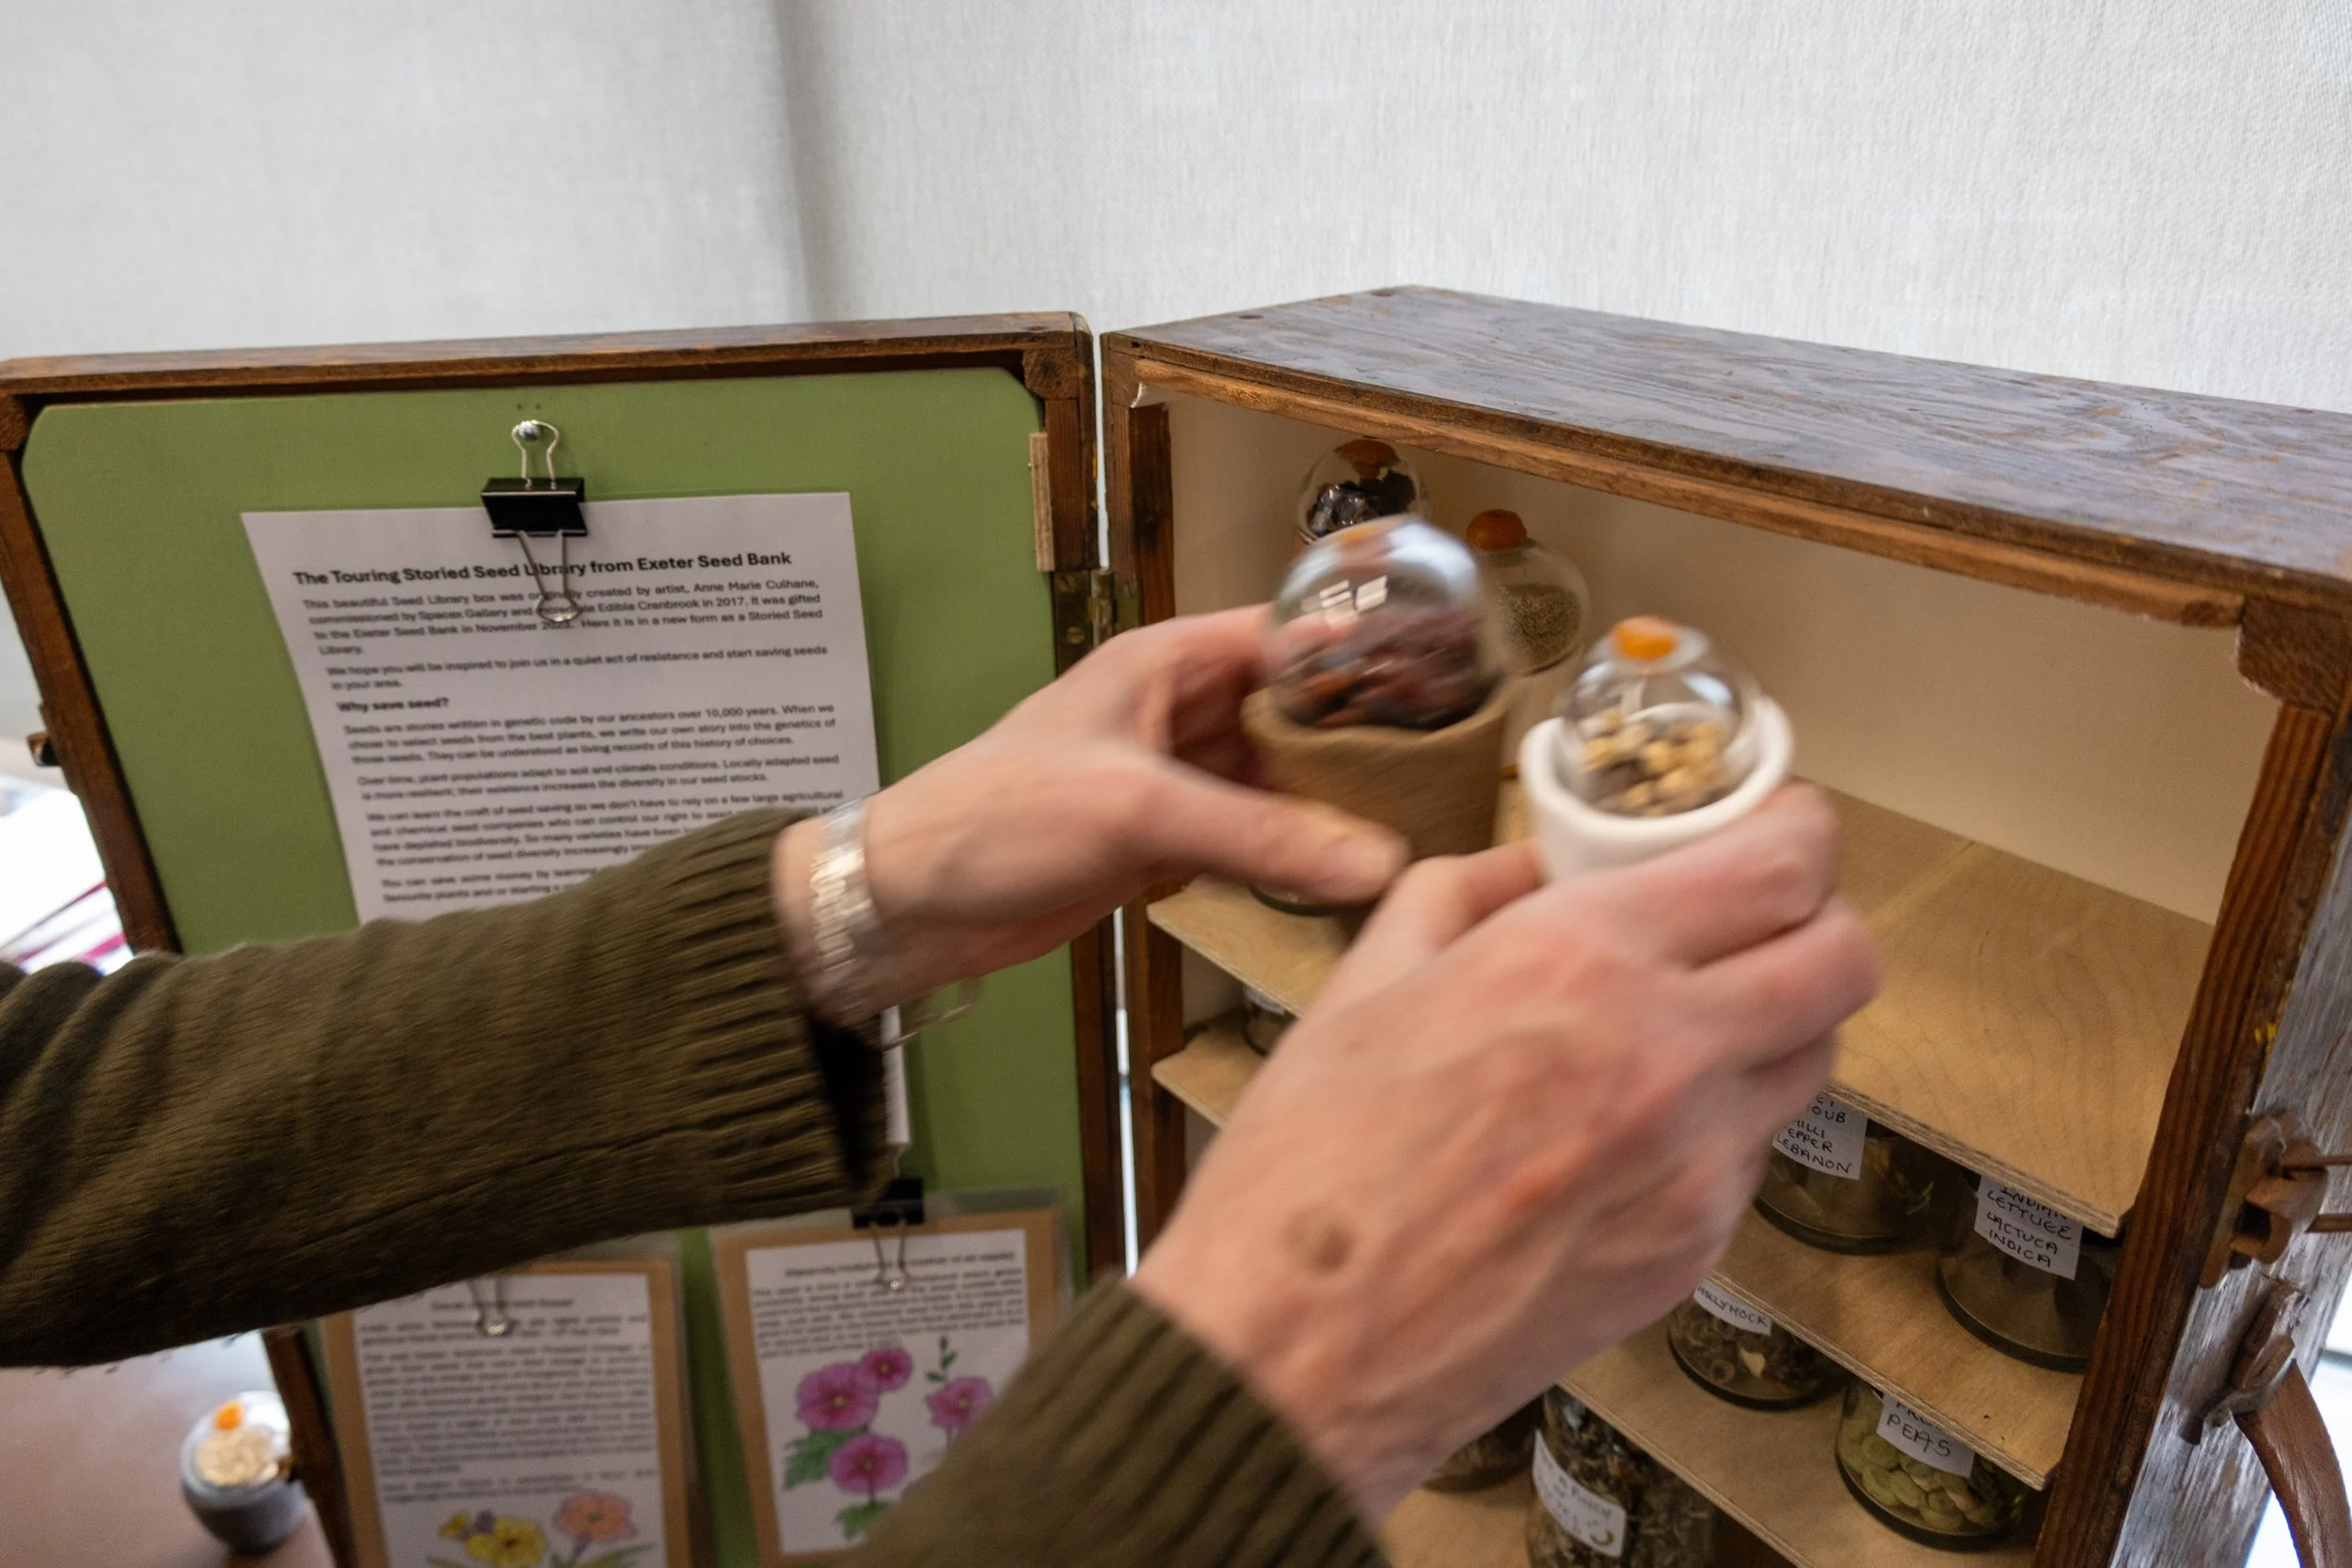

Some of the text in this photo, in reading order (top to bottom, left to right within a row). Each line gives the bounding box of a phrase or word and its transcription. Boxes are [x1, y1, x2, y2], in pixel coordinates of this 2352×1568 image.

[293, 570, 327, 585] The
[330, 567, 401, 587] Touring
[403, 565, 469, 581] Storied
[474, 563, 518, 578] Seed
[590, 559, 632, 573] from
[638, 555, 693, 571] Exeter
[698, 553, 742, 568] Seed
[747, 550, 792, 565] Bank
[586, 587, 631, 598] created
[636, 585, 649, 596] by
[693, 581, 723, 593] Anne
[728, 580, 760, 591] Marie
[597, 601, 634, 612] Edible
[638, 598, 698, 610] Cranbrook
[702, 598, 713, 608] in
[751, 595, 759, 606] It
[761, 596, 785, 605] was
[788, 594, 820, 606] gifted
[581, 617, 609, 628] Here
[612, 617, 619, 626] it
[624, 617, 633, 626] is
[637, 616, 648, 626] in
[652, 617, 659, 626] a
[662, 616, 686, 625] new
[690, 612, 717, 624] form
[721, 613, 734, 622] as
[738, 613, 745, 622] a
[748, 610, 788, 621] Storied
[792, 608, 822, 619] Seed
[563, 657, 570, 666] a
[572, 655, 601, 666] quiet
[604, 654, 623, 664] act
[626, 653, 636, 663] of
[640, 651, 699, 662] resistance
[702, 650, 723, 659] and
[726, 648, 752, 658] start
[755, 647, 790, 658] saving
[793, 645, 827, 656] seeds
[580, 714, 593, 725] by
[596, 714, 614, 723] our
[619, 711, 674, 722] ancestors
[677, 710, 700, 720] over
[706, 706, 742, 719] 10,000
[782, 704, 815, 715] When
[818, 705, 834, 713] we
[599, 729, 615, 737] we
[618, 727, 646, 736] write
[649, 726, 667, 736] our
[671, 725, 694, 735] own
[698, 723, 724, 735] story
[728, 722, 751, 732] into
[754, 721, 771, 731] the
[775, 720, 820, 732] genetics
[824, 718, 835, 728] of
[566, 746, 578, 754] as
[580, 743, 611, 755] living
[612, 741, 654, 752] records
[657, 740, 668, 751] of
[671, 739, 691, 750] this
[693, 737, 731, 750] history
[734, 736, 745, 746] of
[1811, 1105, 1846, 1123] OUB
[1788, 1128, 1833, 1153] EPPER
[1776, 1133, 1851, 1174] LEBANON
[2000, 1186, 2068, 1220] INDIA
[1986, 1212, 2058, 1256] LACTUCA
[1989, 1229, 2051, 1269] INDICA
[1886, 1414, 1951, 1457] PEAS
